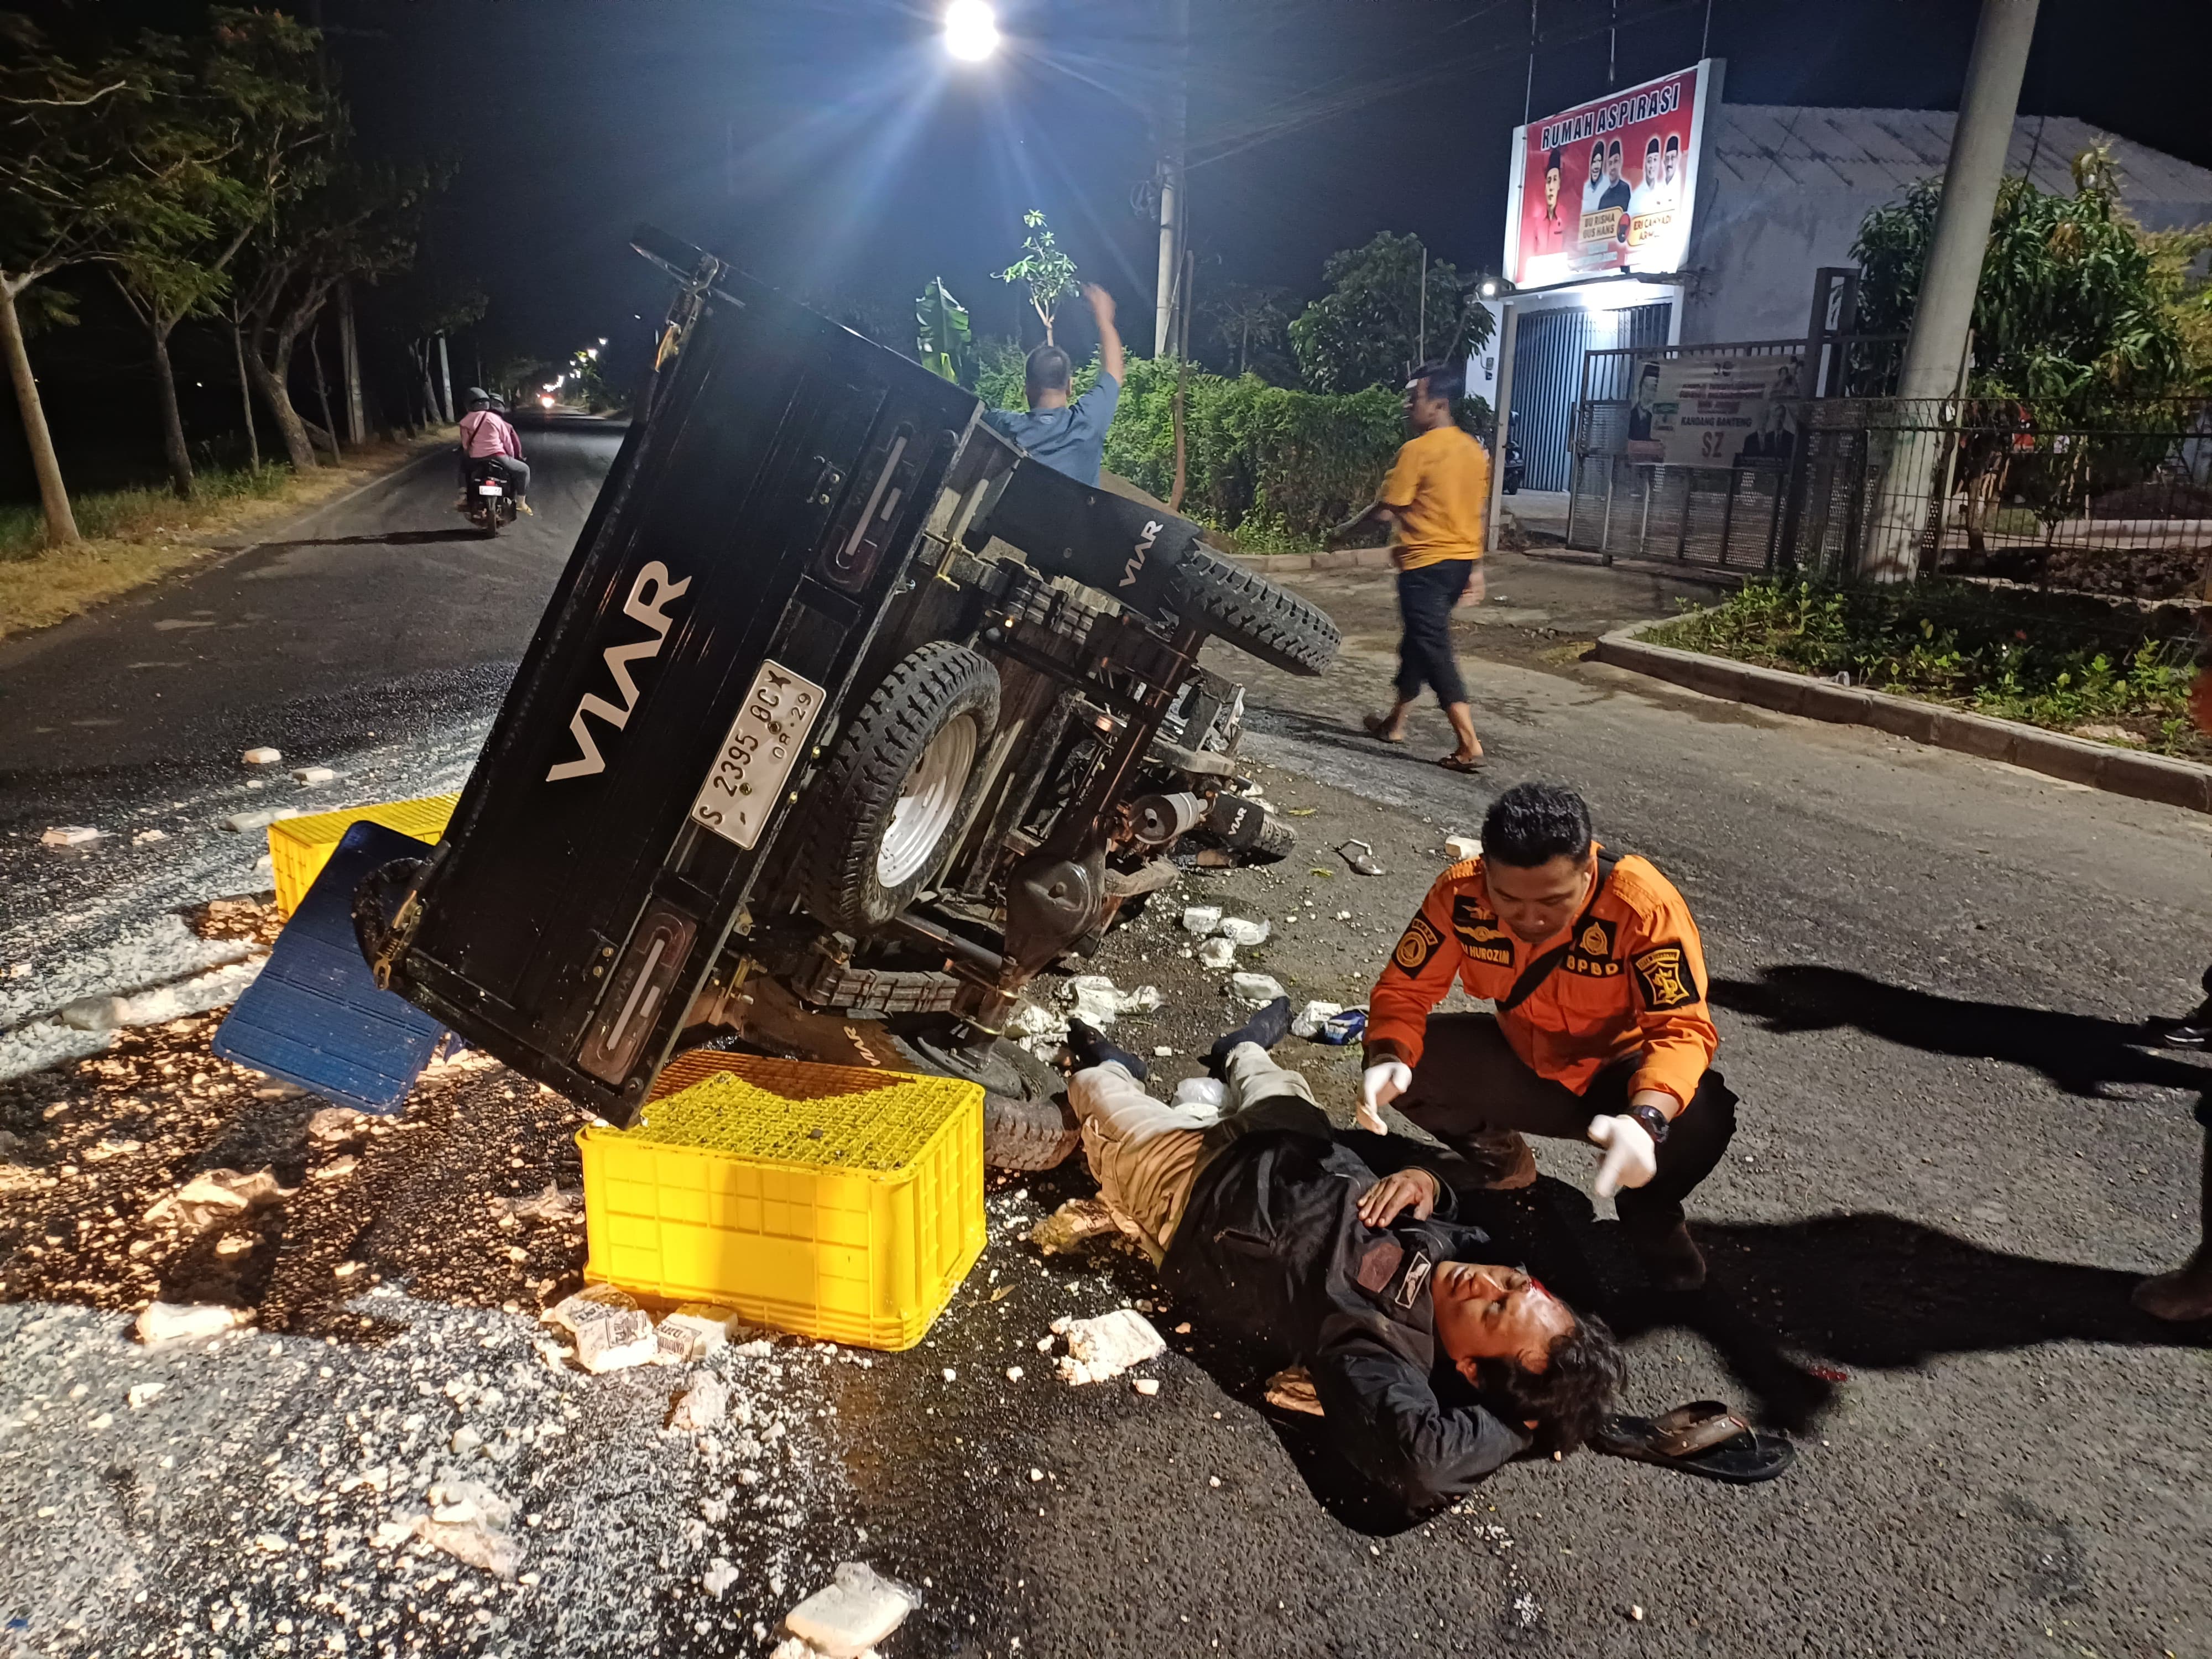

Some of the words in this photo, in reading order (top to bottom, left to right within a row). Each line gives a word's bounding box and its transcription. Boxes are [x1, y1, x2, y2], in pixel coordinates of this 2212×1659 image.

[1541, 112, 1594, 150] RUMAH
[1596, 83, 1680, 134] ASPIRASI
[1119, 520, 1164, 587] VIAR
[545, 560, 692, 782] VIAR
[699, 805, 724, 825] S
[713, 729, 759, 797] 2395
[1228, 807, 1248, 836] VIAR
[1567, 955, 1619, 975] BPBD
[843, 1026, 881, 1066] VIAR
